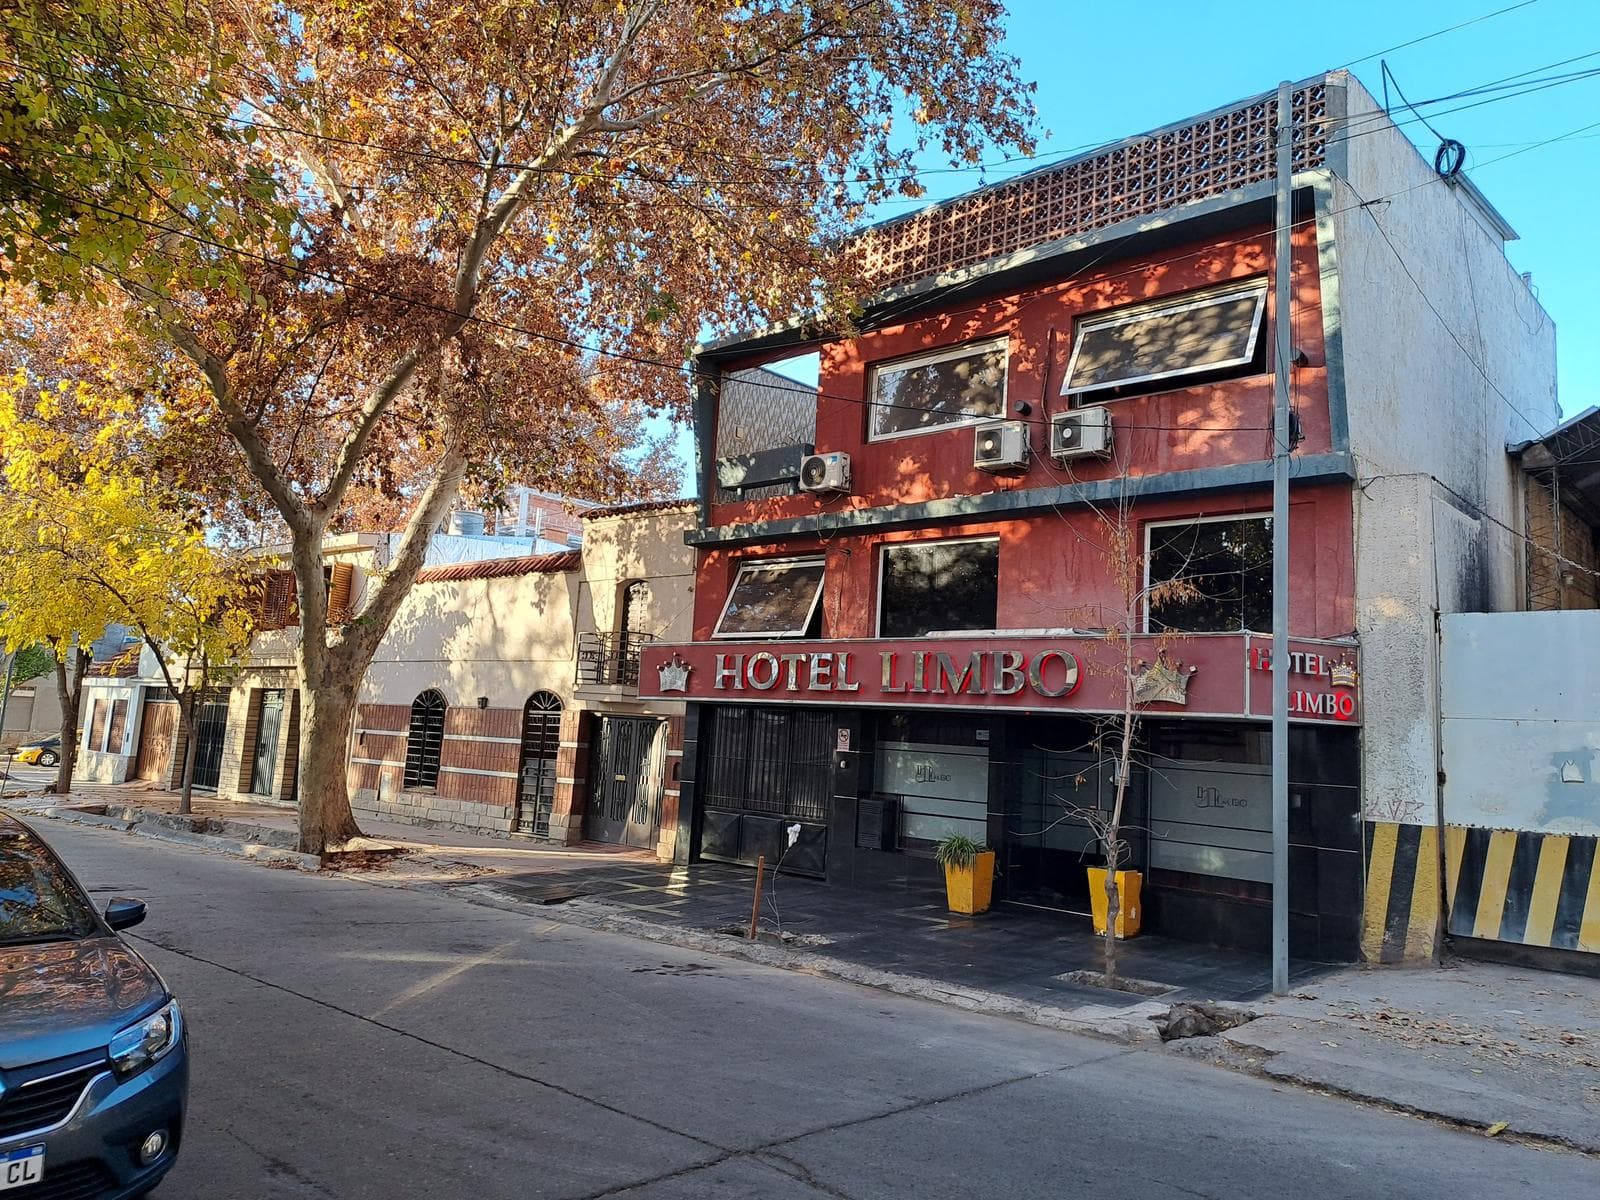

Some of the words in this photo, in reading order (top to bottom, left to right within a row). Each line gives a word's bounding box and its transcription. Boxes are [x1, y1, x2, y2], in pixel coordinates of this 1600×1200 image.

[713, 651, 861, 691] HOTEL
[879, 650, 1081, 698] LIMBO
[1256, 647, 1330, 676] HTEL
[8, 1160, 36, 1184] CL
